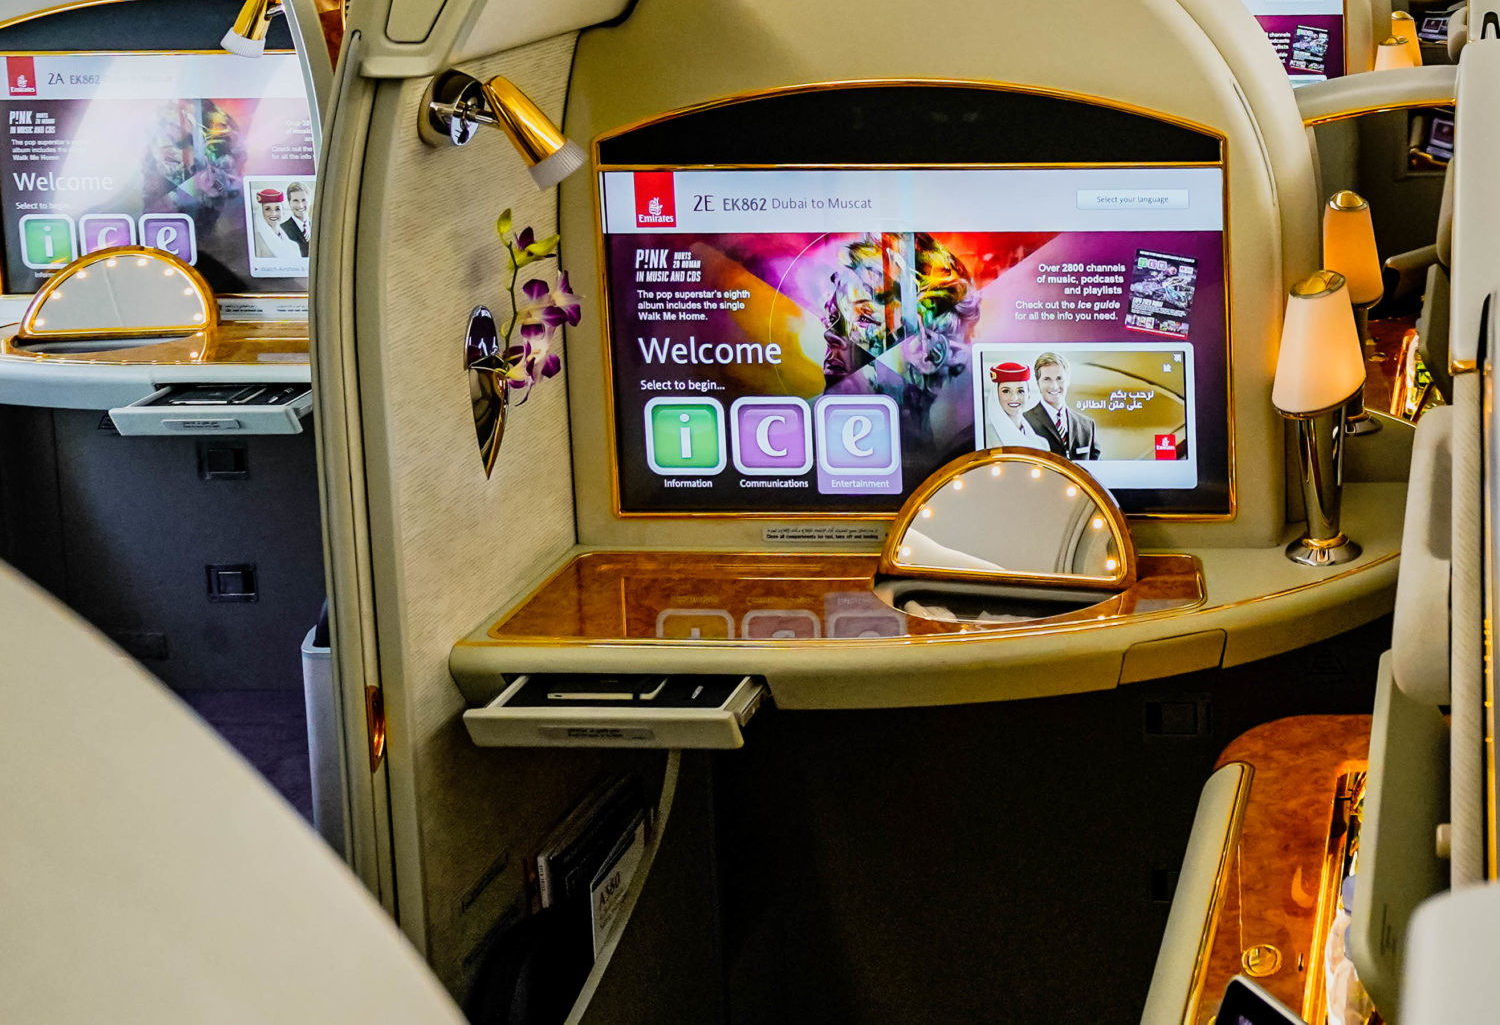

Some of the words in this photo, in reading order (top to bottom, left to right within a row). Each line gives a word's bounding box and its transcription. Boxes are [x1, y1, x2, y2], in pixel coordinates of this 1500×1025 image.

[48, 73, 64, 84] 2A
[70, 75, 100, 84] EK862
[10, 111, 33, 124] P!NK
[13, 172, 113, 191] Welcome
[693, 195, 715, 211] 2E
[723, 198, 767, 211] EK862
[772, 198, 807, 209] Dubai
[812, 199, 824, 209] to
[828, 199, 872, 209] Muscat
[1138, 196, 1168, 205] language
[639, 214, 674, 223] Emirates
[635, 249, 669, 269] P!NK
[1039, 264, 1060, 272] Over
[1086, 264, 1125, 272] channels
[1037, 275, 1046, 283] of
[1048, 275, 1079, 284] music,
[1081, 275, 1124, 285] podcasts
[638, 290, 654, 299] The
[656, 292, 672, 301] pop
[675, 290, 721, 301] superstar's
[724, 290, 750, 301] eighth
[1064, 286, 1080, 294] and
[1083, 286, 1122, 296] playlists
[638, 301, 664, 310] album
[666, 301, 701, 310] includes
[704, 301, 717, 310] the
[720, 301, 745, 311] single
[1015, 300, 1043, 309] Check
[1061, 301, 1075, 309] the
[1094, 301, 1120, 310] guide
[638, 312, 660, 320] Walk
[663, 312, 676, 320] Me
[679, 312, 708, 320] Home.
[1015, 312, 1027, 320] for
[1029, 312, 1038, 320] all
[1041, 312, 1055, 320] the
[1057, 312, 1073, 320] info
[1075, 313, 1091, 322] you
[1094, 312, 1118, 320] need.
[638, 336, 782, 364] Welcome
[641, 380, 672, 390] Select
[675, 381, 686, 390] to
[688, 380, 725, 392] begin...
[680, 414, 691, 458] i
[756, 416, 787, 457] c
[842, 415, 874, 457] e
[664, 479, 712, 488] Information
[740, 479, 808, 488] Communications
[831, 479, 889, 488] Entertainment
